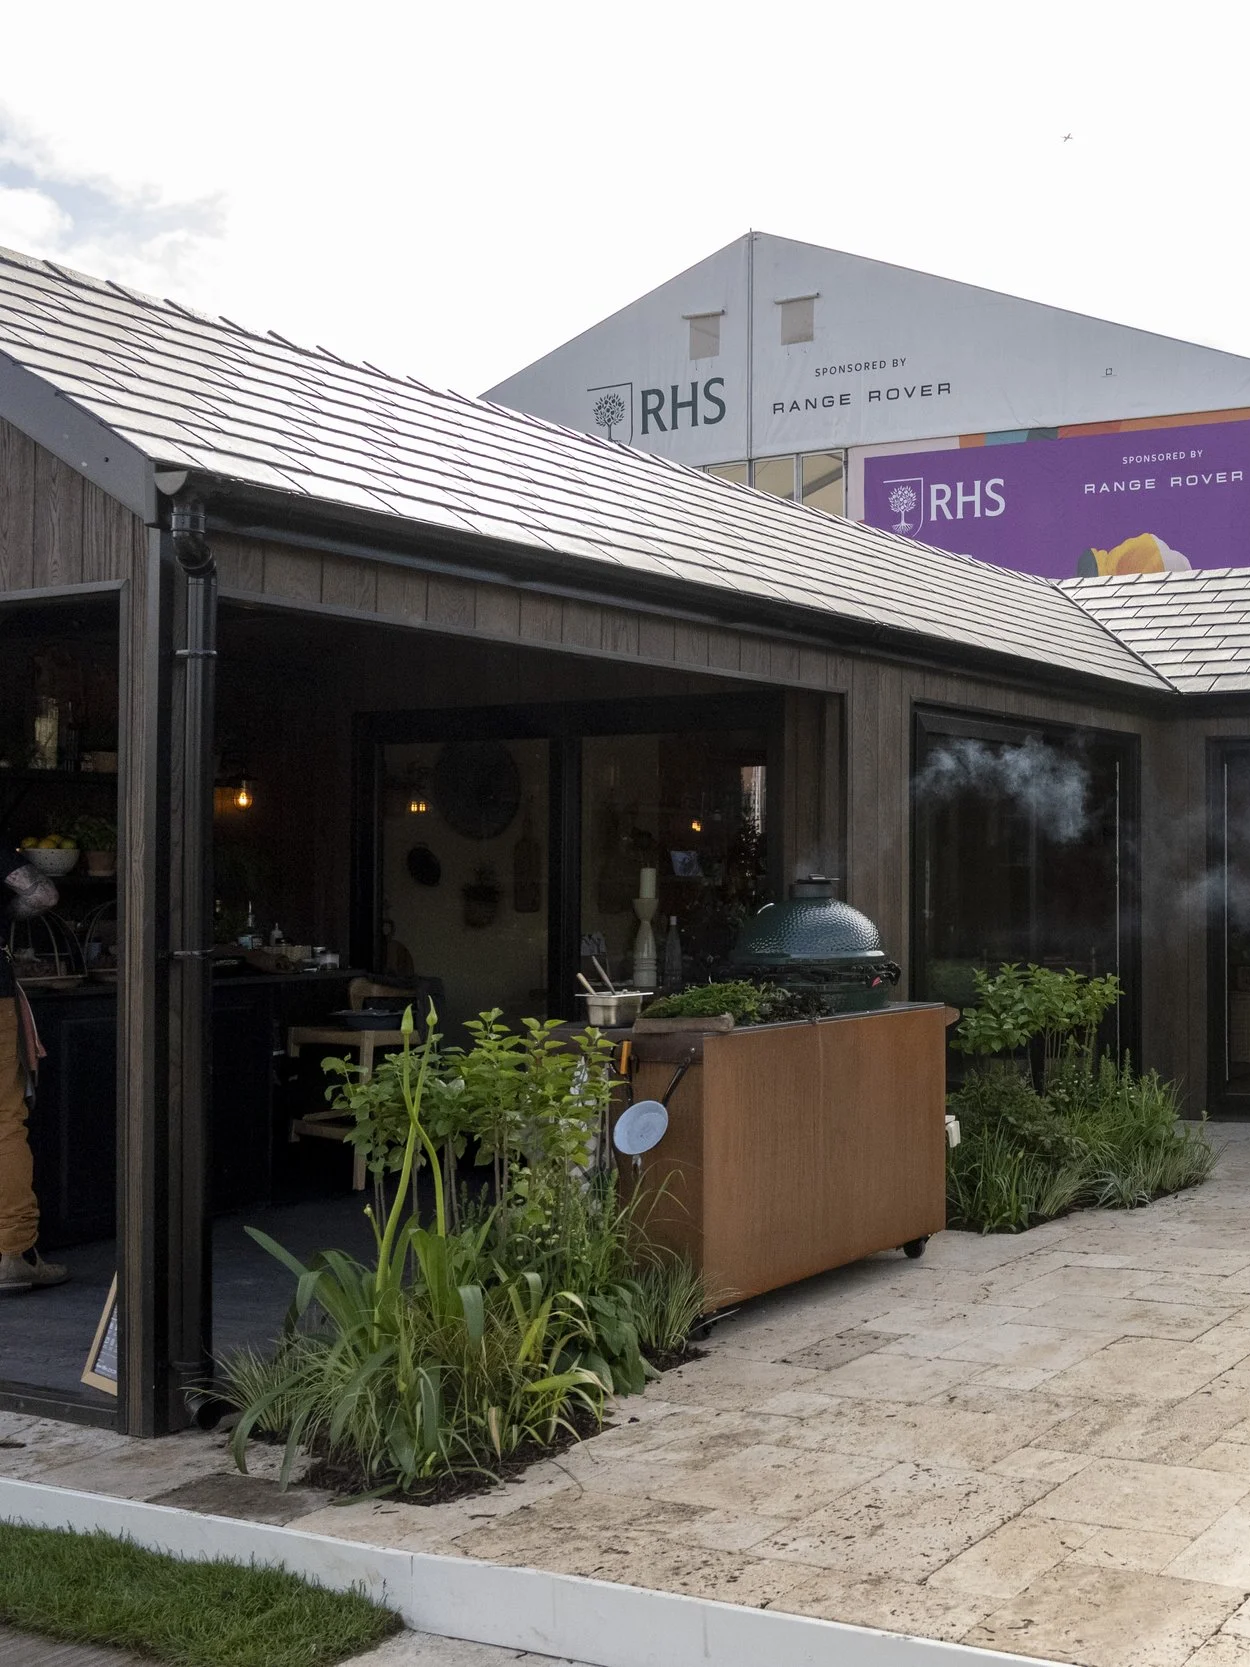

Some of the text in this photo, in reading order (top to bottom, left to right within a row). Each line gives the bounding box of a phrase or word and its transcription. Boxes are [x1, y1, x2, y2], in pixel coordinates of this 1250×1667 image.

[814, 357, 907, 377] SPONSORED BY
[640, 376, 726, 436] RHS
[772, 382, 951, 415] RANGE ROVER
[1122, 449, 1204, 465] SPONSORED BY
[1084, 470, 1244, 494] RANGE ROVER
[929, 478, 1006, 522] RHS
